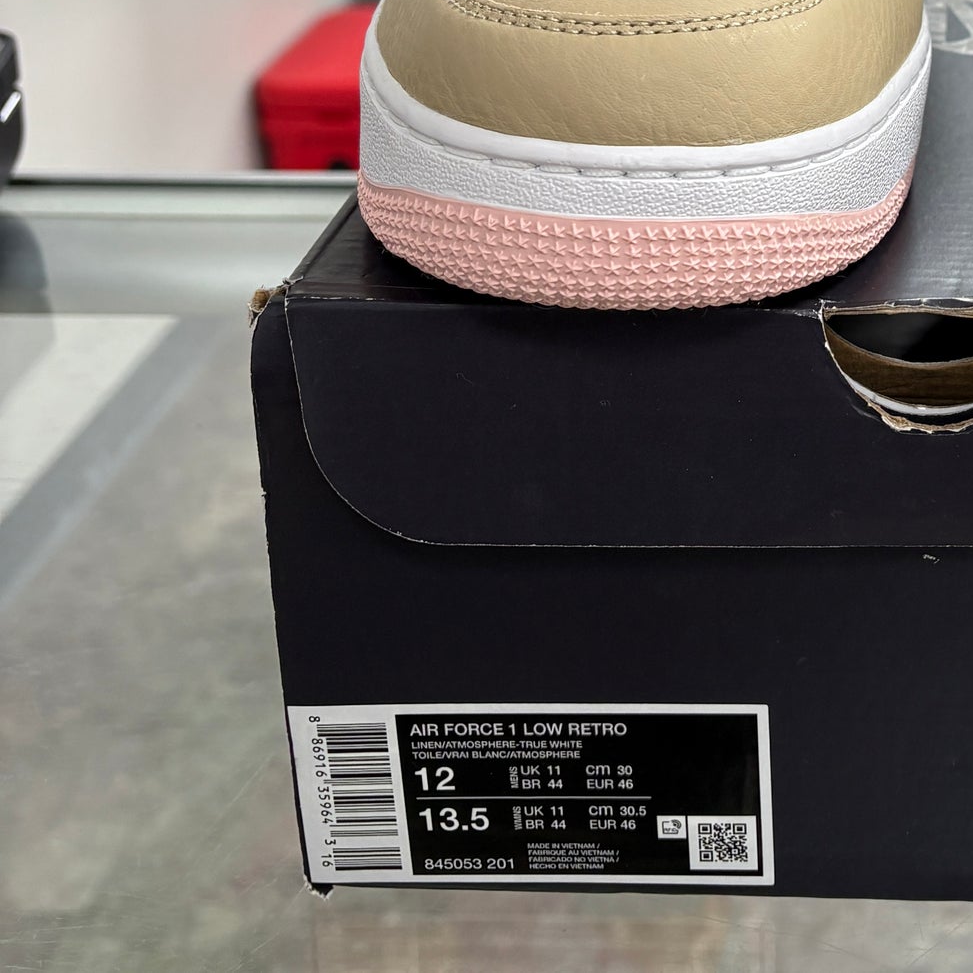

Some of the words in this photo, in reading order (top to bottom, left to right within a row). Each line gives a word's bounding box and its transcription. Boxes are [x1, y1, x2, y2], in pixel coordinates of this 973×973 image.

[309, 715, 320, 723] 8
[410, 723, 439, 736] AIR
[444, 723, 504, 736] FORCE
[508, 723, 516, 736] 1
[524, 723, 562, 736] LOW
[568, 722, 627, 736] RETRO
[411, 740, 548, 749] LINEN/ATMOSPHERE-TRUE
[549, 740, 583, 749] WHITE
[412, 751, 469, 760] TOILE/VRAI
[472, 750, 581, 759] BLANC/ATMOSPHERE
[520, 765, 541, 775] UK
[547, 765, 561, 775] 11
[617, 765, 633, 775] 30
[414, 766, 456, 791] 12
[509, 766, 519, 789] MENS
[522, 779, 541, 789] BR
[547, 779, 563, 789] 44
[586, 779, 614, 789] EUR
[618, 779, 634, 789] 46
[524, 806, 544, 816] UK
[550, 806, 564, 816] 11
[620, 806, 647, 816] 30.5
[419, 807, 490, 831] 13.5
[513, 806, 523, 830] WMNS
[525, 820, 544, 830] BR
[551, 820, 566, 830] 44
[589, 819, 617, 829] EUR
[620, 819, 636, 830] 46
[424, 858, 483, 871] 845053
[486, 858, 515, 871] 201
